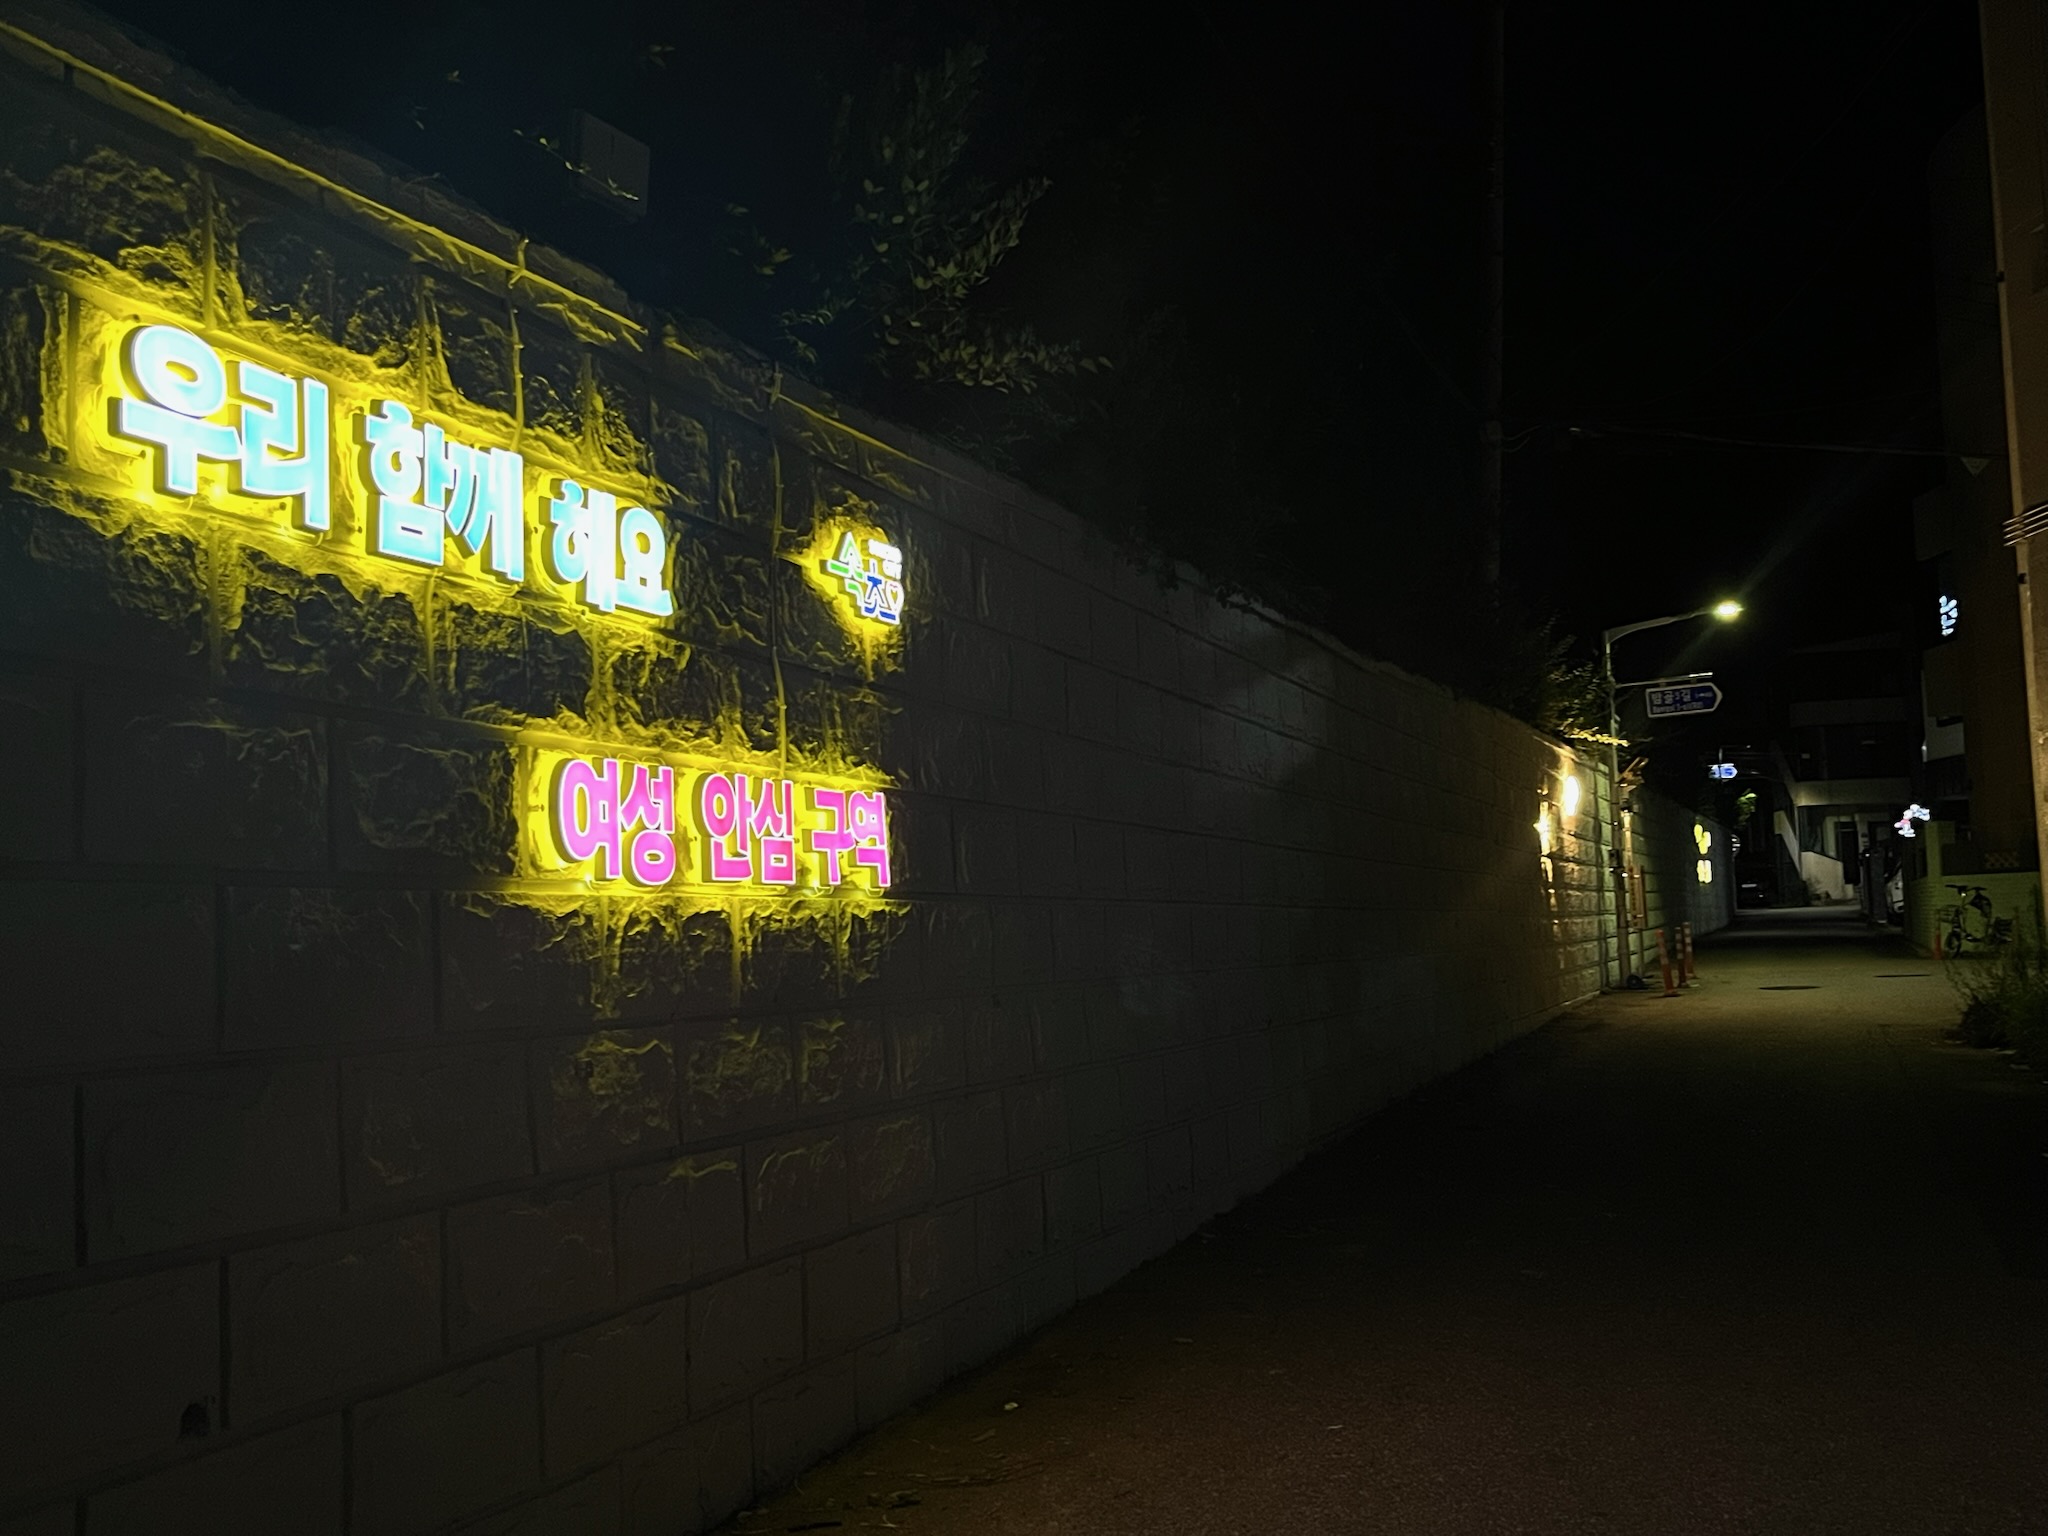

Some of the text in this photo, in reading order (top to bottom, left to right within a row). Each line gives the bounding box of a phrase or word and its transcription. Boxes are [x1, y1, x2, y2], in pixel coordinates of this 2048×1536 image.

[118, 324, 674, 617] 우리 함께 해요
[558, 758, 891, 887] 여성 안심 구역
